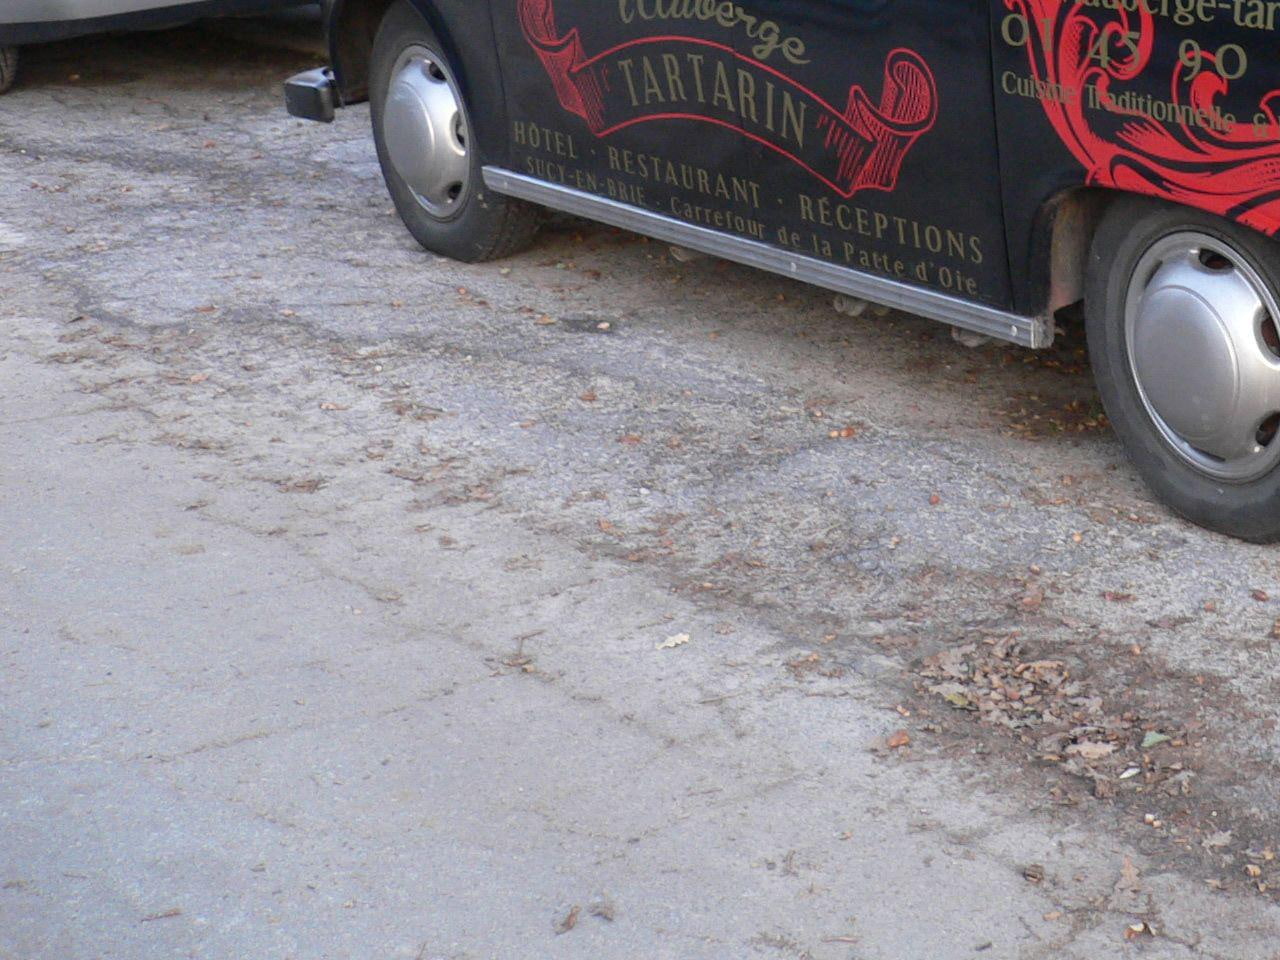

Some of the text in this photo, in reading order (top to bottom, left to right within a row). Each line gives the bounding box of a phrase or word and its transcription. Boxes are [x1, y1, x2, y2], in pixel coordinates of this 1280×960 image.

[1000, 12, 1053, 53] 01
[1088, 26, 1142, 72] 45
[1178, 37, 1248, 82] 90
[617, 52, 808, 149] TARTARIN
[1001, 70, 1078, 104] Cuisine
[1085, 83, 1237, 135] Traditionnelle
[607, 145, 761, 209] RESTAURANT
[799, 193, 984, 265] RÉCEPTIONS
[669, 195, 766, 240] Carrefour
[777, 225, 801, 247] de
[812, 234, 833, 258] la
[843, 241, 905, 277] Patte
